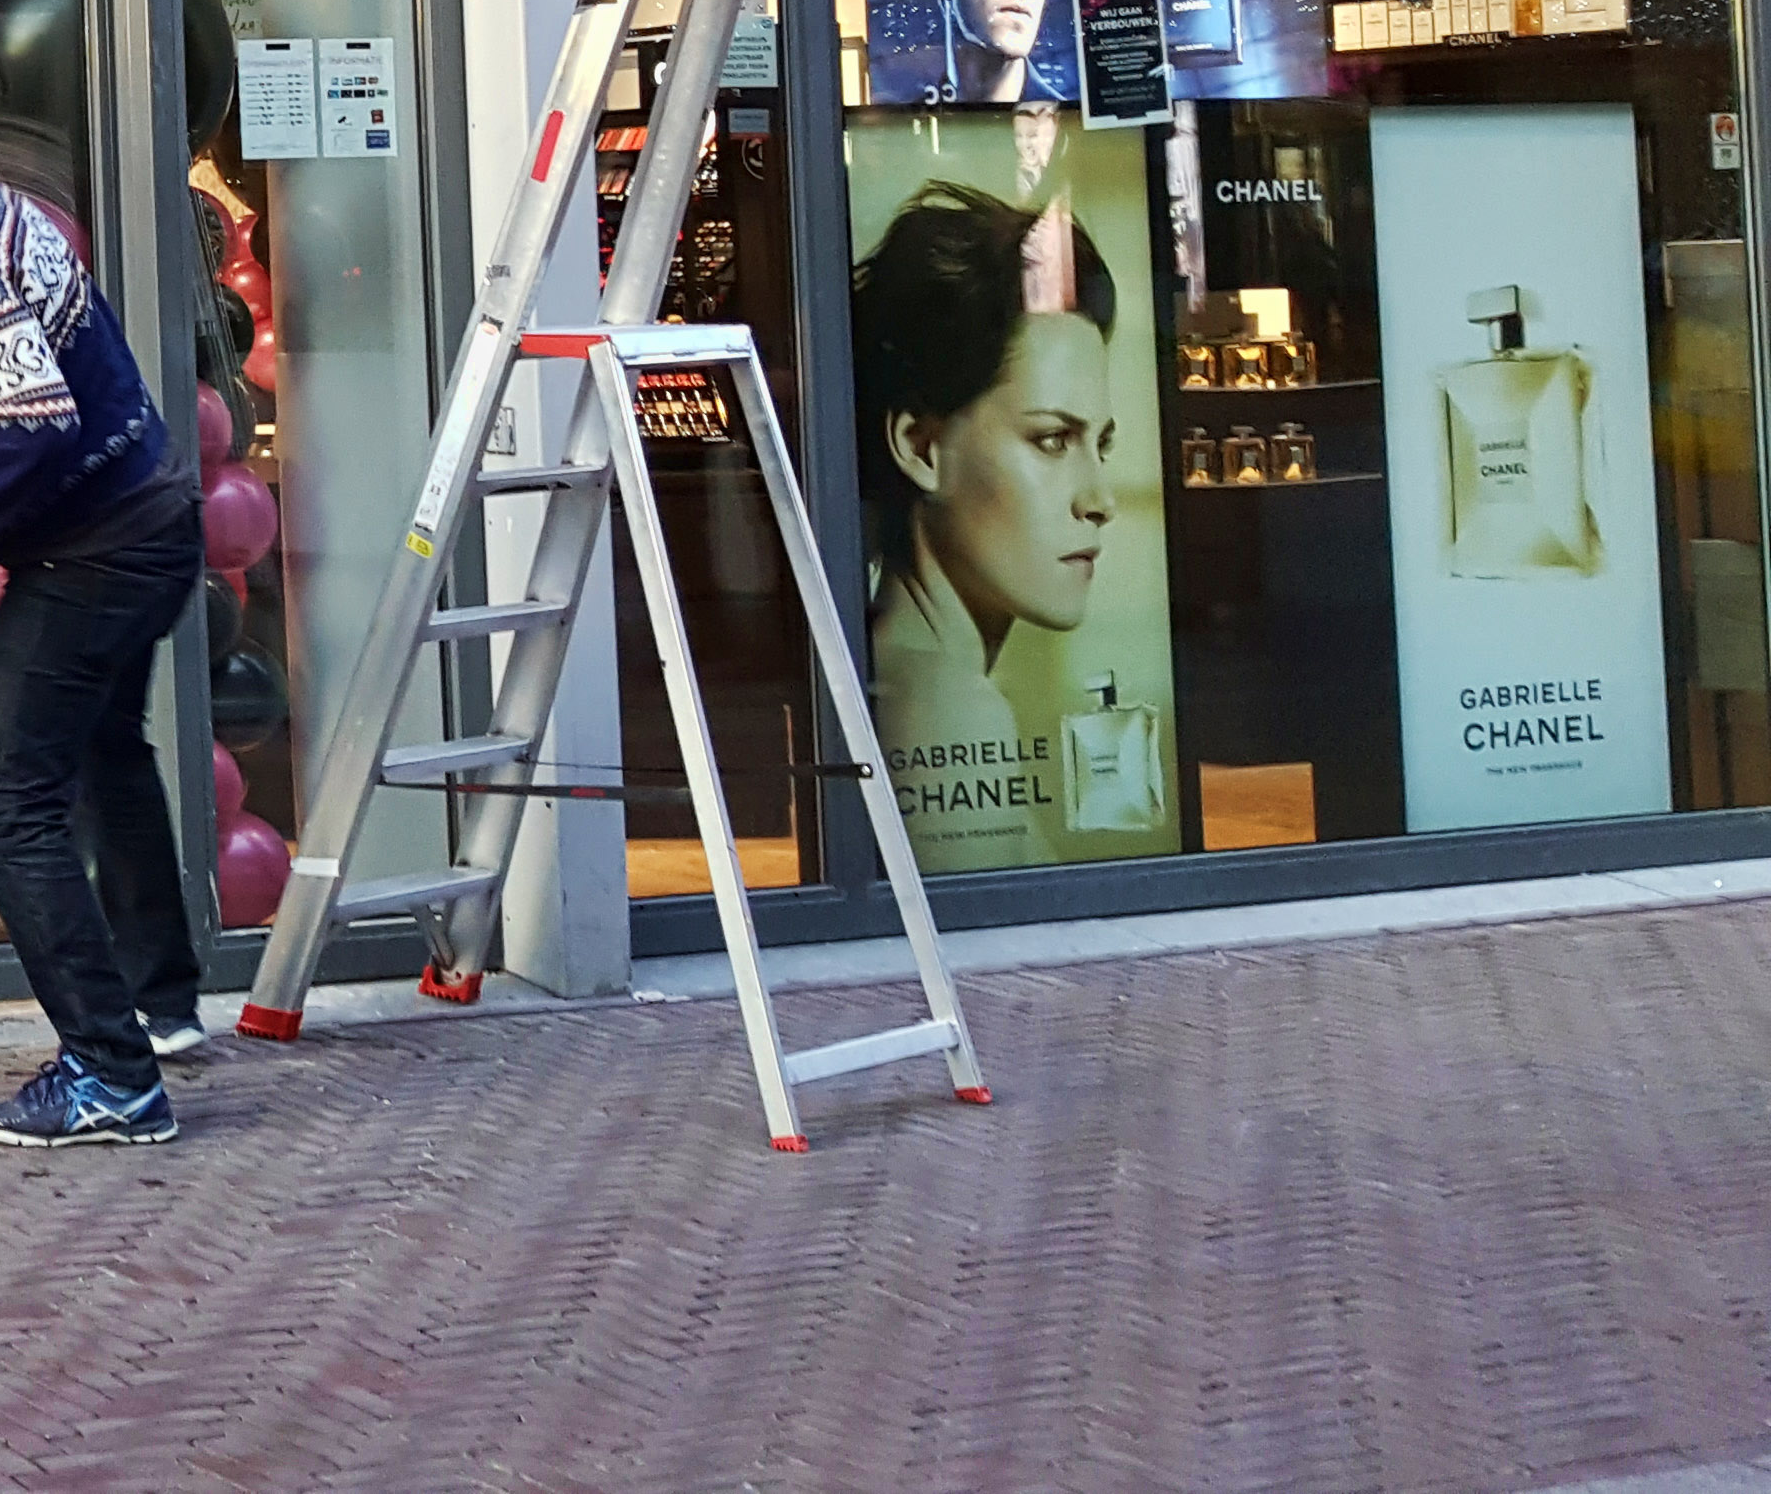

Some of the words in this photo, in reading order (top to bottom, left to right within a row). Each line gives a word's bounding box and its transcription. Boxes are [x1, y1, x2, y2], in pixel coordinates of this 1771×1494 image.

[1118, 6, 1143, 17] GAAN
[1171, 0, 1212, 12] CHANEL
[1090, 16, 1153, 31] VERBOUWEN
[1448, 32, 1502, 47] CHANEL
[1216, 178, 1323, 203] CHANEL
[1481, 462, 1528, 477] CHANEL
[1460, 678, 1603, 710] GABRIELLE
[1463, 713, 1605, 752] CHANEL
[888, 735, 1051, 773] GABRIELLE
[896, 774, 1053, 816] CHANEL
